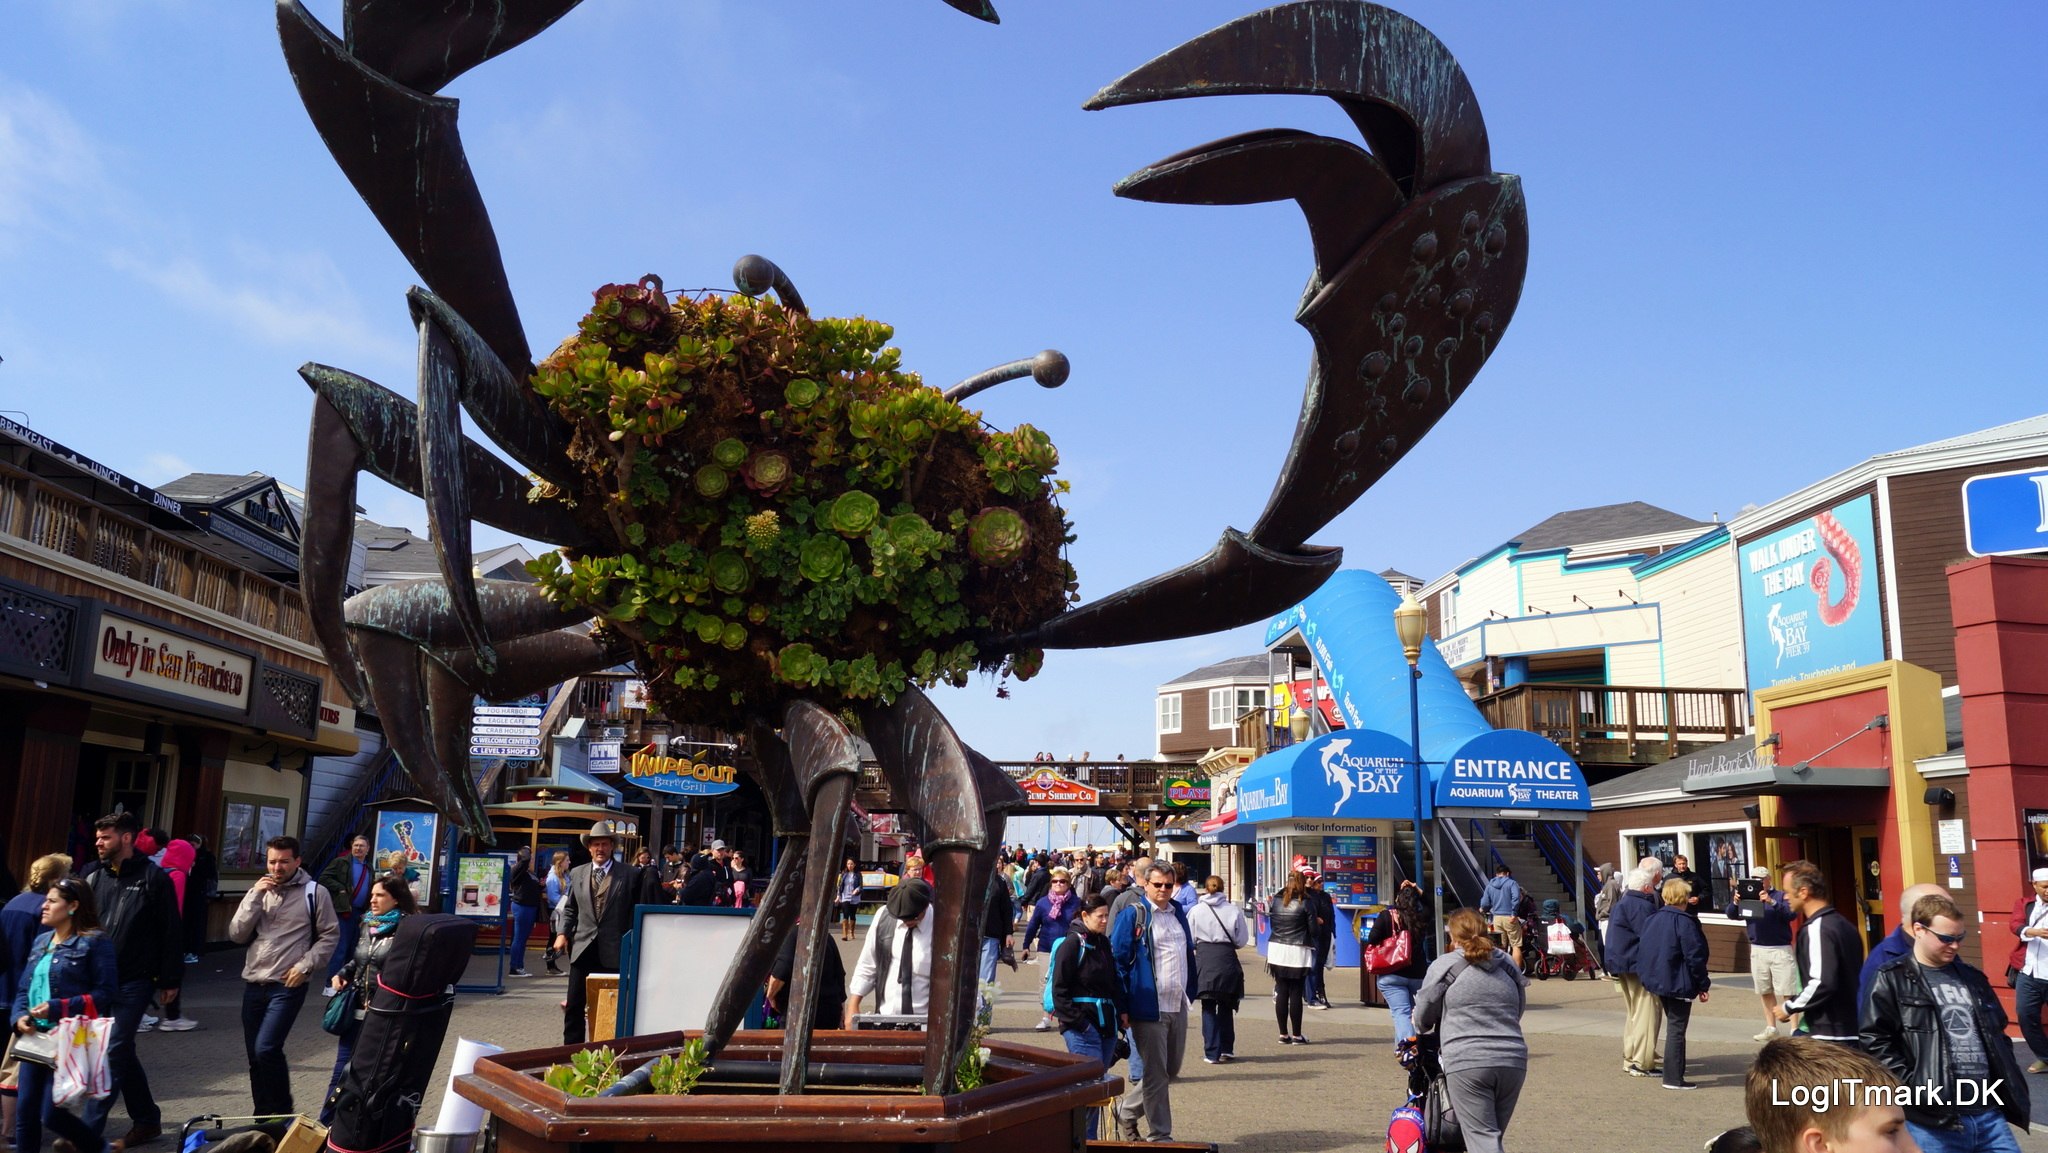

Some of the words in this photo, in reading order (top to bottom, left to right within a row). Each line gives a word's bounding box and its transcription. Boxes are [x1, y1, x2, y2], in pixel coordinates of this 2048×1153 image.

[153, 492, 182, 515] DINNER
[1749, 543, 1777, 574] WALK
[1778, 528, 1816, 563] UNDER
[1762, 570, 1784, 597] THE
[1784, 560, 1805, 590] BAY
[1777, 610, 1808, 628] AQUARIUM
[1785, 625, 1808, 646] BAY
[102, 626, 140, 679] Only
[140, 637, 156, 674] in
[157, 642, 183, 680] San
[184, 650, 244, 697] Francisco
[1786, 645, 1802, 658] PIER
[1842, 659, 1856, 671] and
[591, 744, 618, 758] ATM
[632, 753, 737, 784] WIPEOUT
[1340, 753, 1404, 771] AQUARIUM
[1455, 759, 1571, 780] ENTRANCE
[1688, 756, 1715, 777] Hard
[1715, 752, 1742, 775] Rock
[1745, 750, 1778, 771] Store
[654, 776, 674, 787] Bar
[681, 779, 706, 793] Grill
[1357, 771, 1404, 794] BAY
[1048, 790, 1077, 800] SHRIMP
[1239, 787, 1264, 819] AQUARIUM
[1275, 777, 1288, 806] BAY
[1450, 787, 1504, 799] AQUARIUM
[1536, 790, 1579, 800] THEATER
[1294, 823, 1319, 832] Visitor
[1322, 823, 1377, 833] Information
